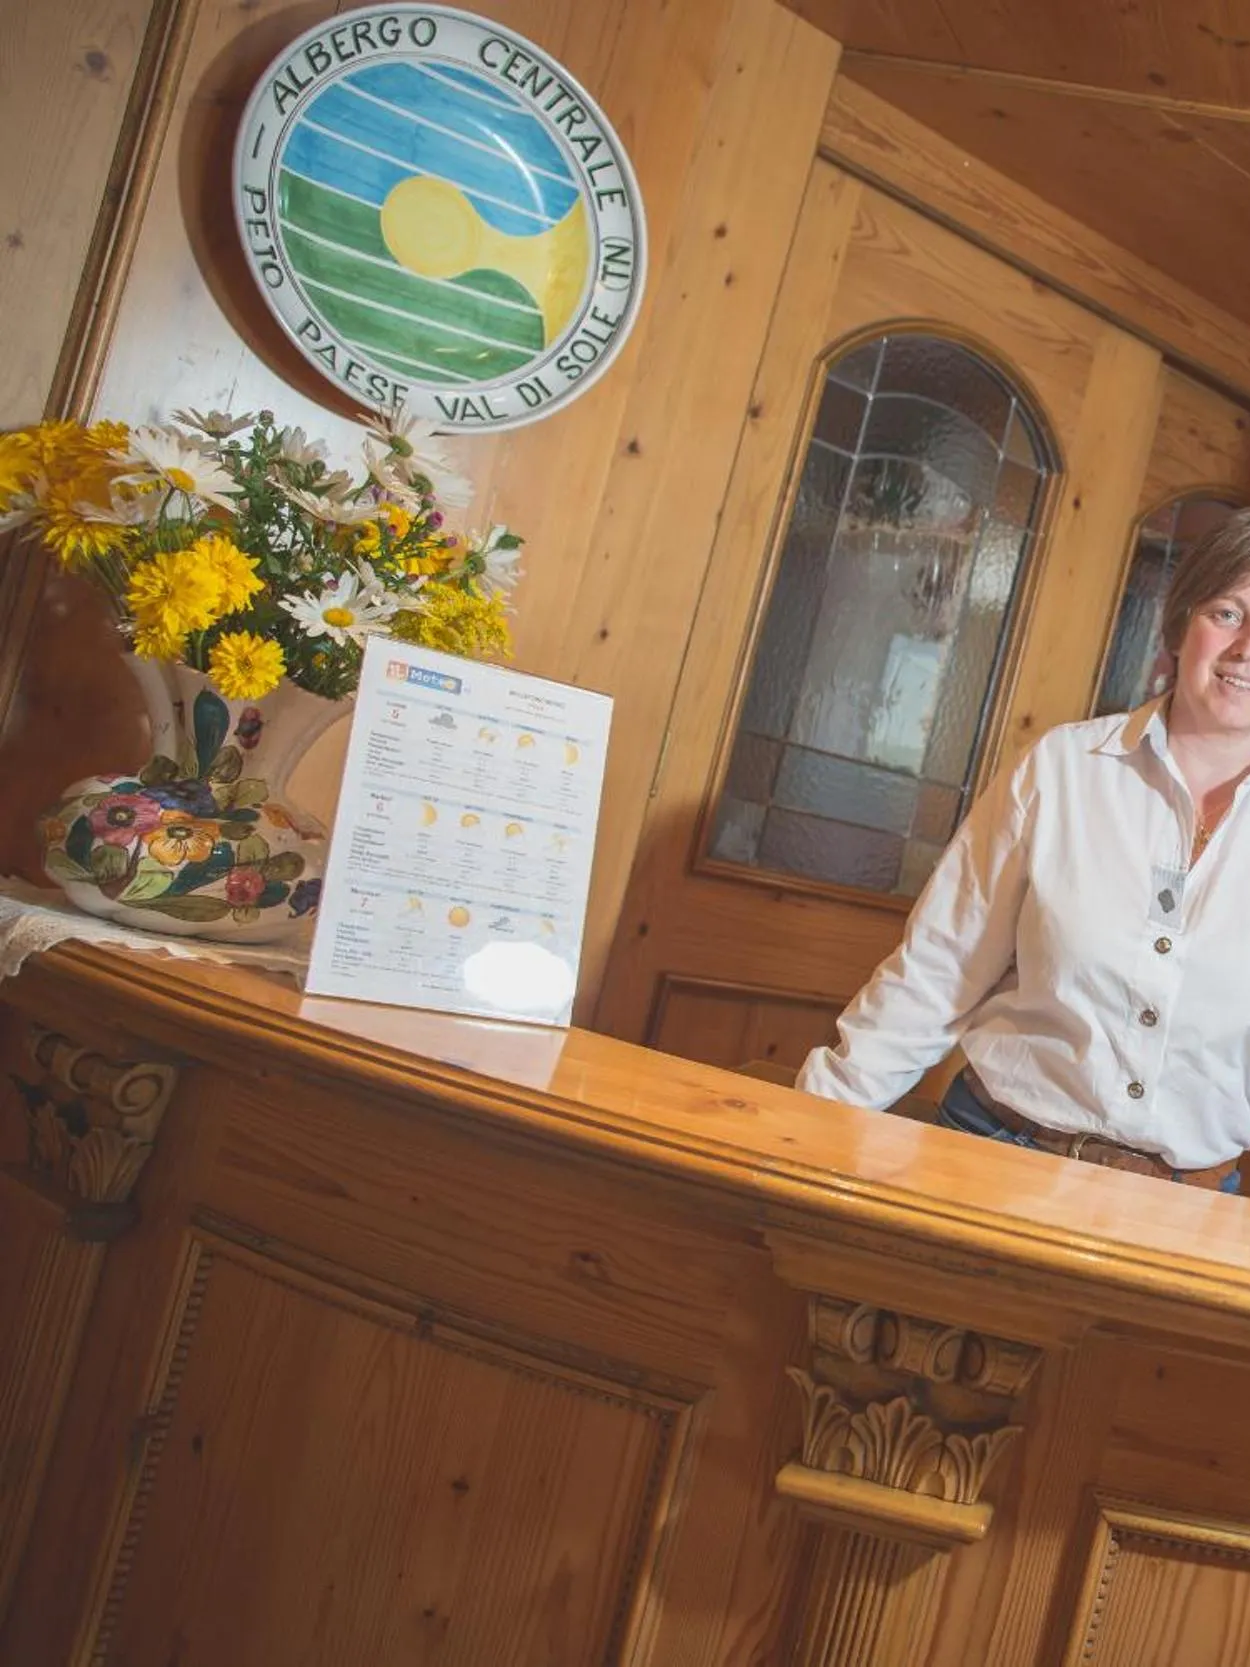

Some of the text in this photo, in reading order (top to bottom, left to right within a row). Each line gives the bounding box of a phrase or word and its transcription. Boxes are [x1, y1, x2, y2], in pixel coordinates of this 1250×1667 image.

[272, 16, 629, 212] ALBERGO CENTRALE
[434, 393, 509, 423] VAL
[515, 376, 553, 407] DI
[556, 306, 624, 379] SOLE
[600, 235, 634, 293] (TN)
